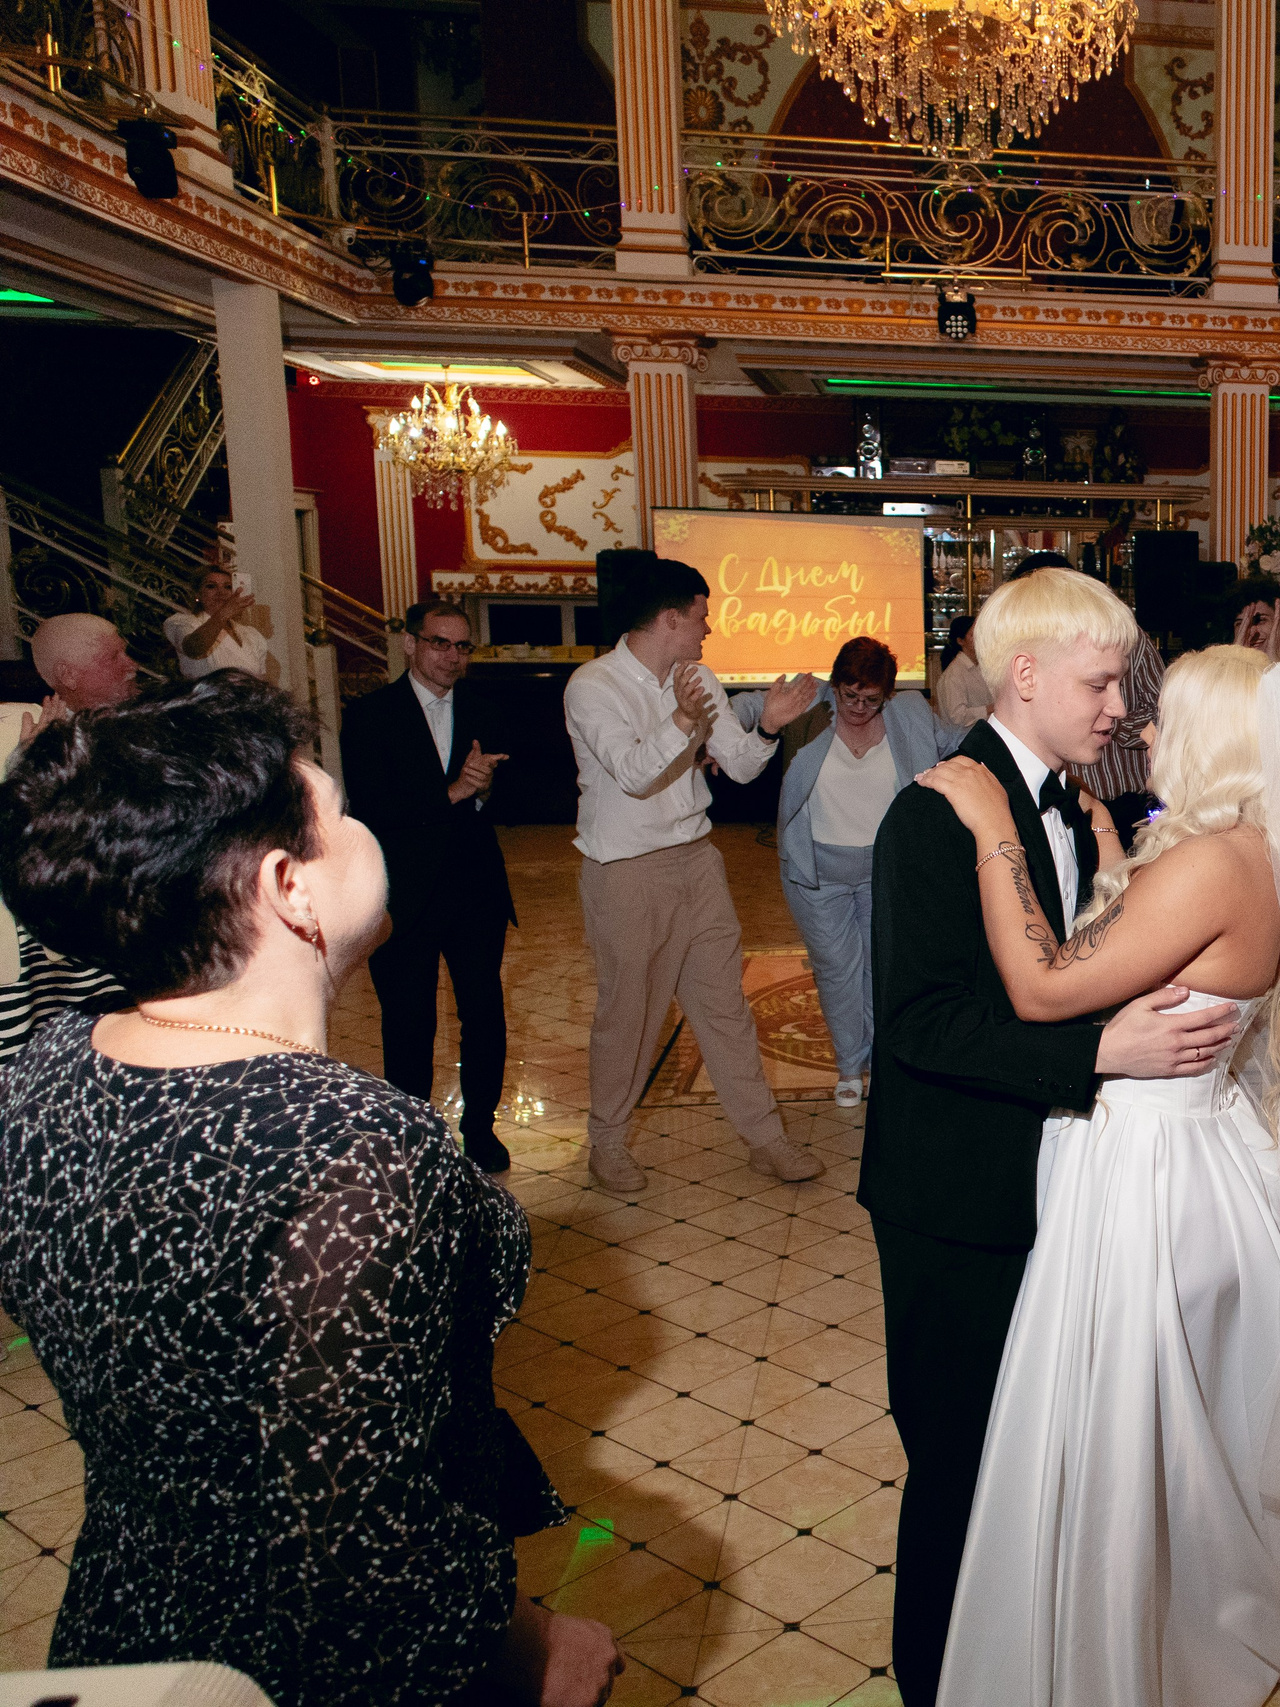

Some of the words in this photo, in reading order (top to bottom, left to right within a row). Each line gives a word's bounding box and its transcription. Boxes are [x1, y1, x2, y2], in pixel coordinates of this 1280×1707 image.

[719, 553, 748, 594] С
[756, 556, 864, 597] Днем
[711, 594, 892, 645] вадьбы!
